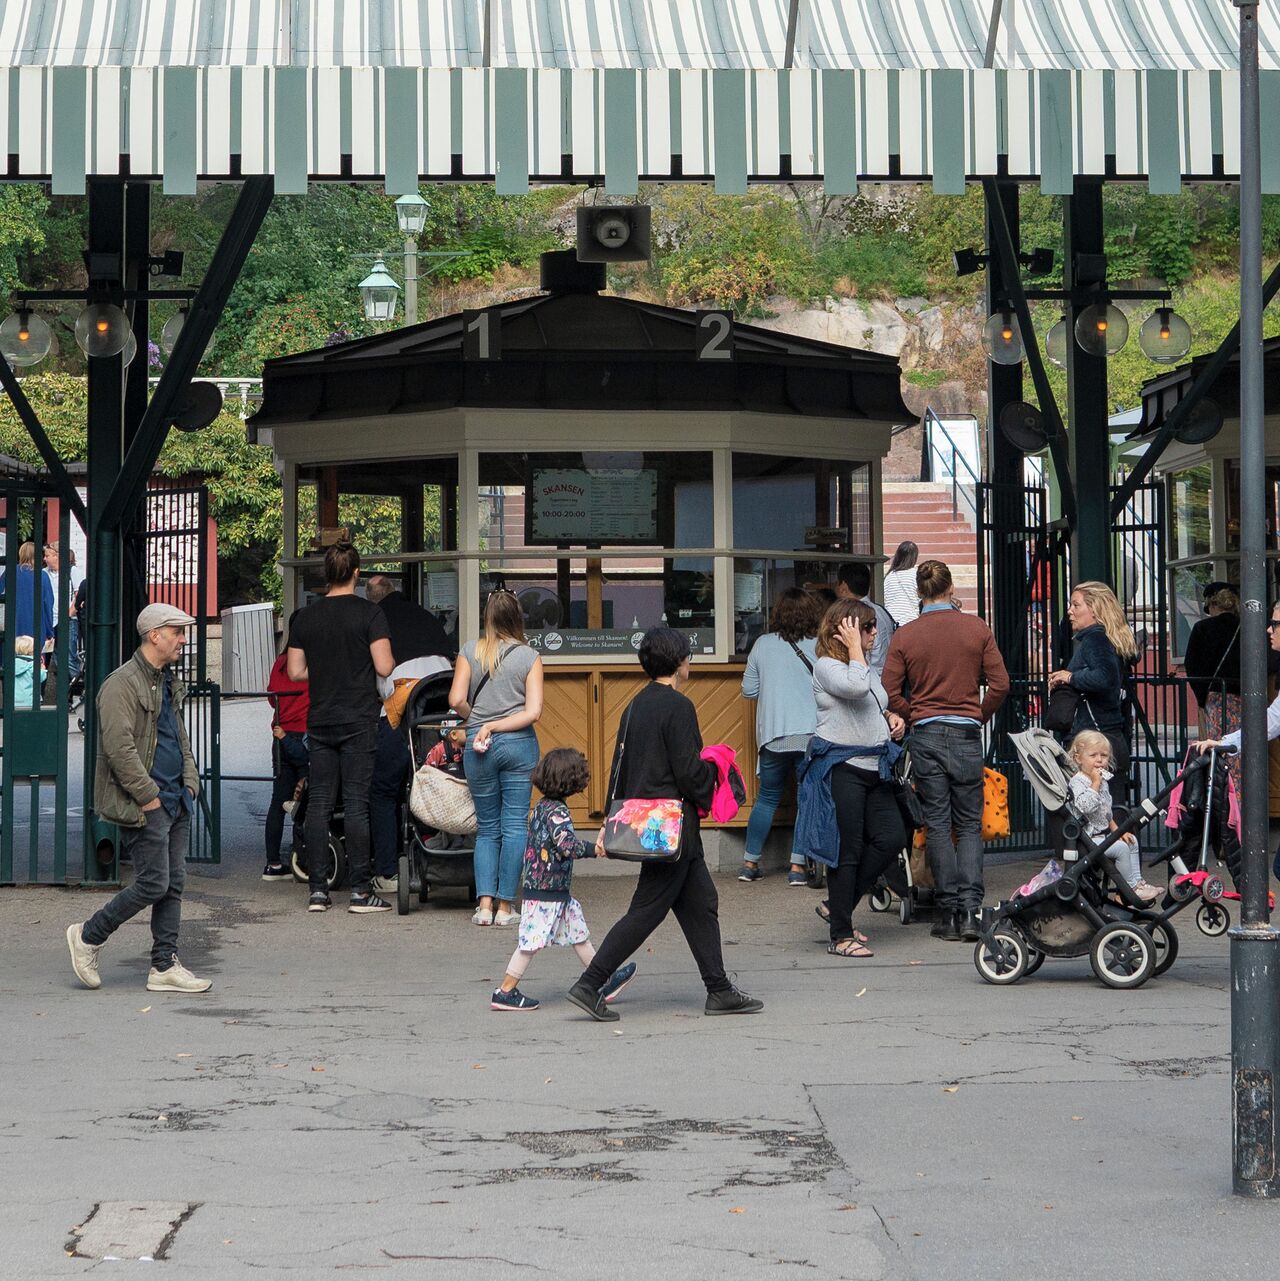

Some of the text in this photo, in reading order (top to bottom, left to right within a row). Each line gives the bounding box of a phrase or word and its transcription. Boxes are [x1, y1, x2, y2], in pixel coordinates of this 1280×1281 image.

[468, 313, 489, 359] 1
[700, 313, 731, 359] 2
[543, 484, 585, 496] SKANSEN
[542, 510, 586, 518] 10:00-20:00
